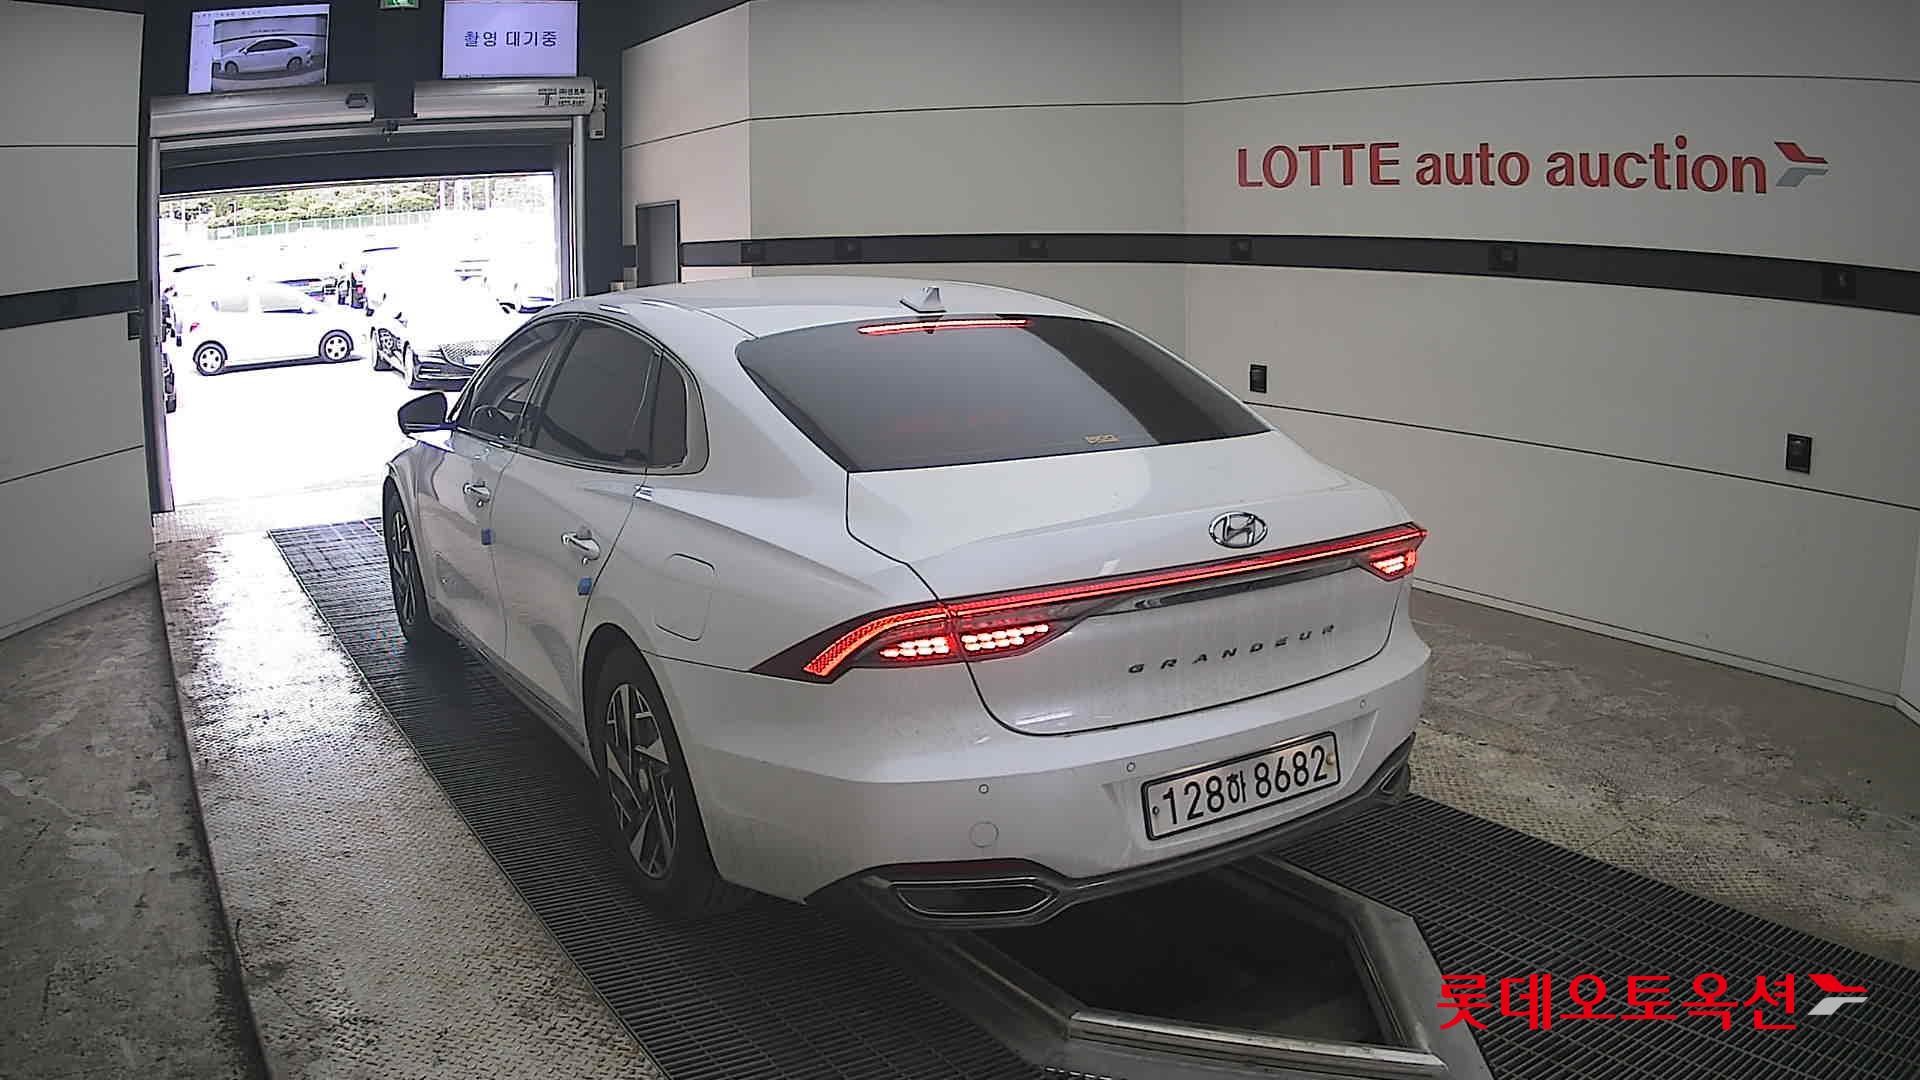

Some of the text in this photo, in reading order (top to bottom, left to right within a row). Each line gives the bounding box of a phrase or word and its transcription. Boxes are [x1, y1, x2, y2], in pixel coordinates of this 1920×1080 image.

[464, 31, 557, 47] 촬영 대기중
[1237, 135, 1767, 194] LOTTE auto auction
[1128, 624, 1334, 673] GRANDEUR
[1163, 745, 1327, 825] 128하 8682
